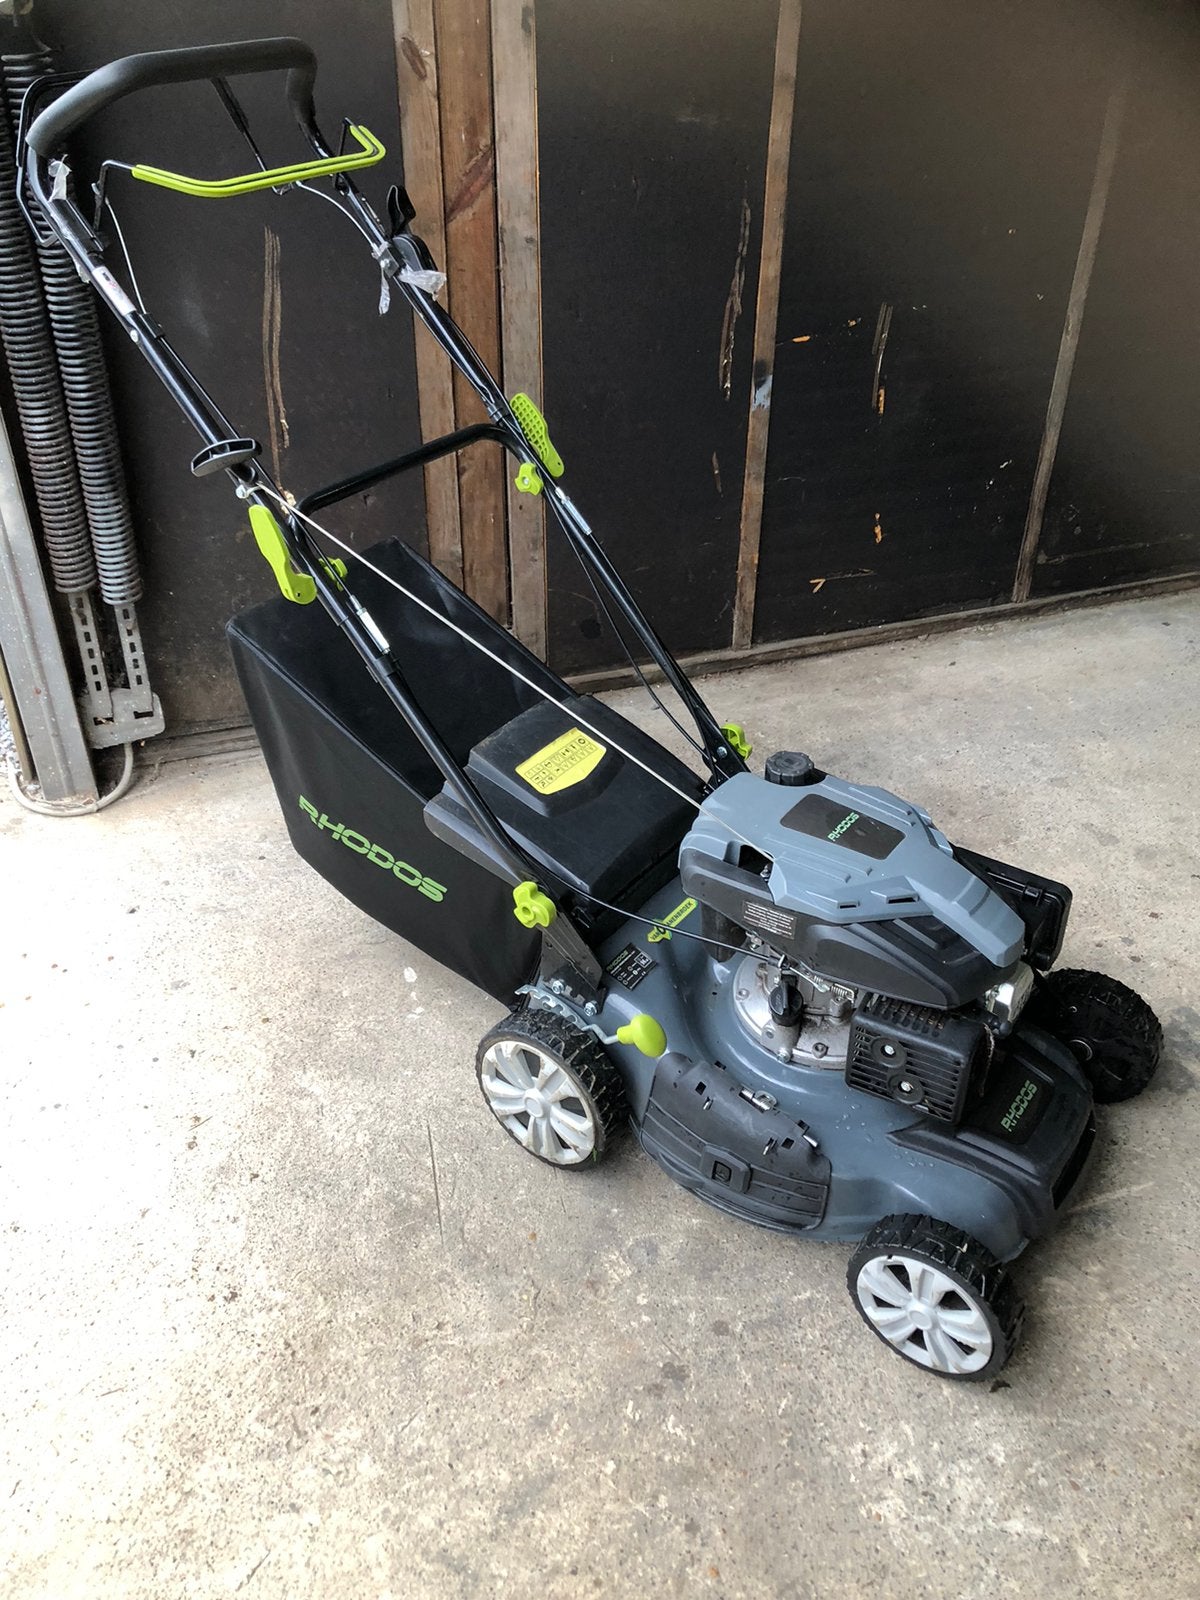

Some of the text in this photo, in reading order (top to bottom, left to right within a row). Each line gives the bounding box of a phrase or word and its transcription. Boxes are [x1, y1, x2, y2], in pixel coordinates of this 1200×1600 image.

[299, 794, 448, 903] RHODOS
[827, 811, 860, 842] RHODOS
[1000, 1080, 1038, 1132] RHODOS
